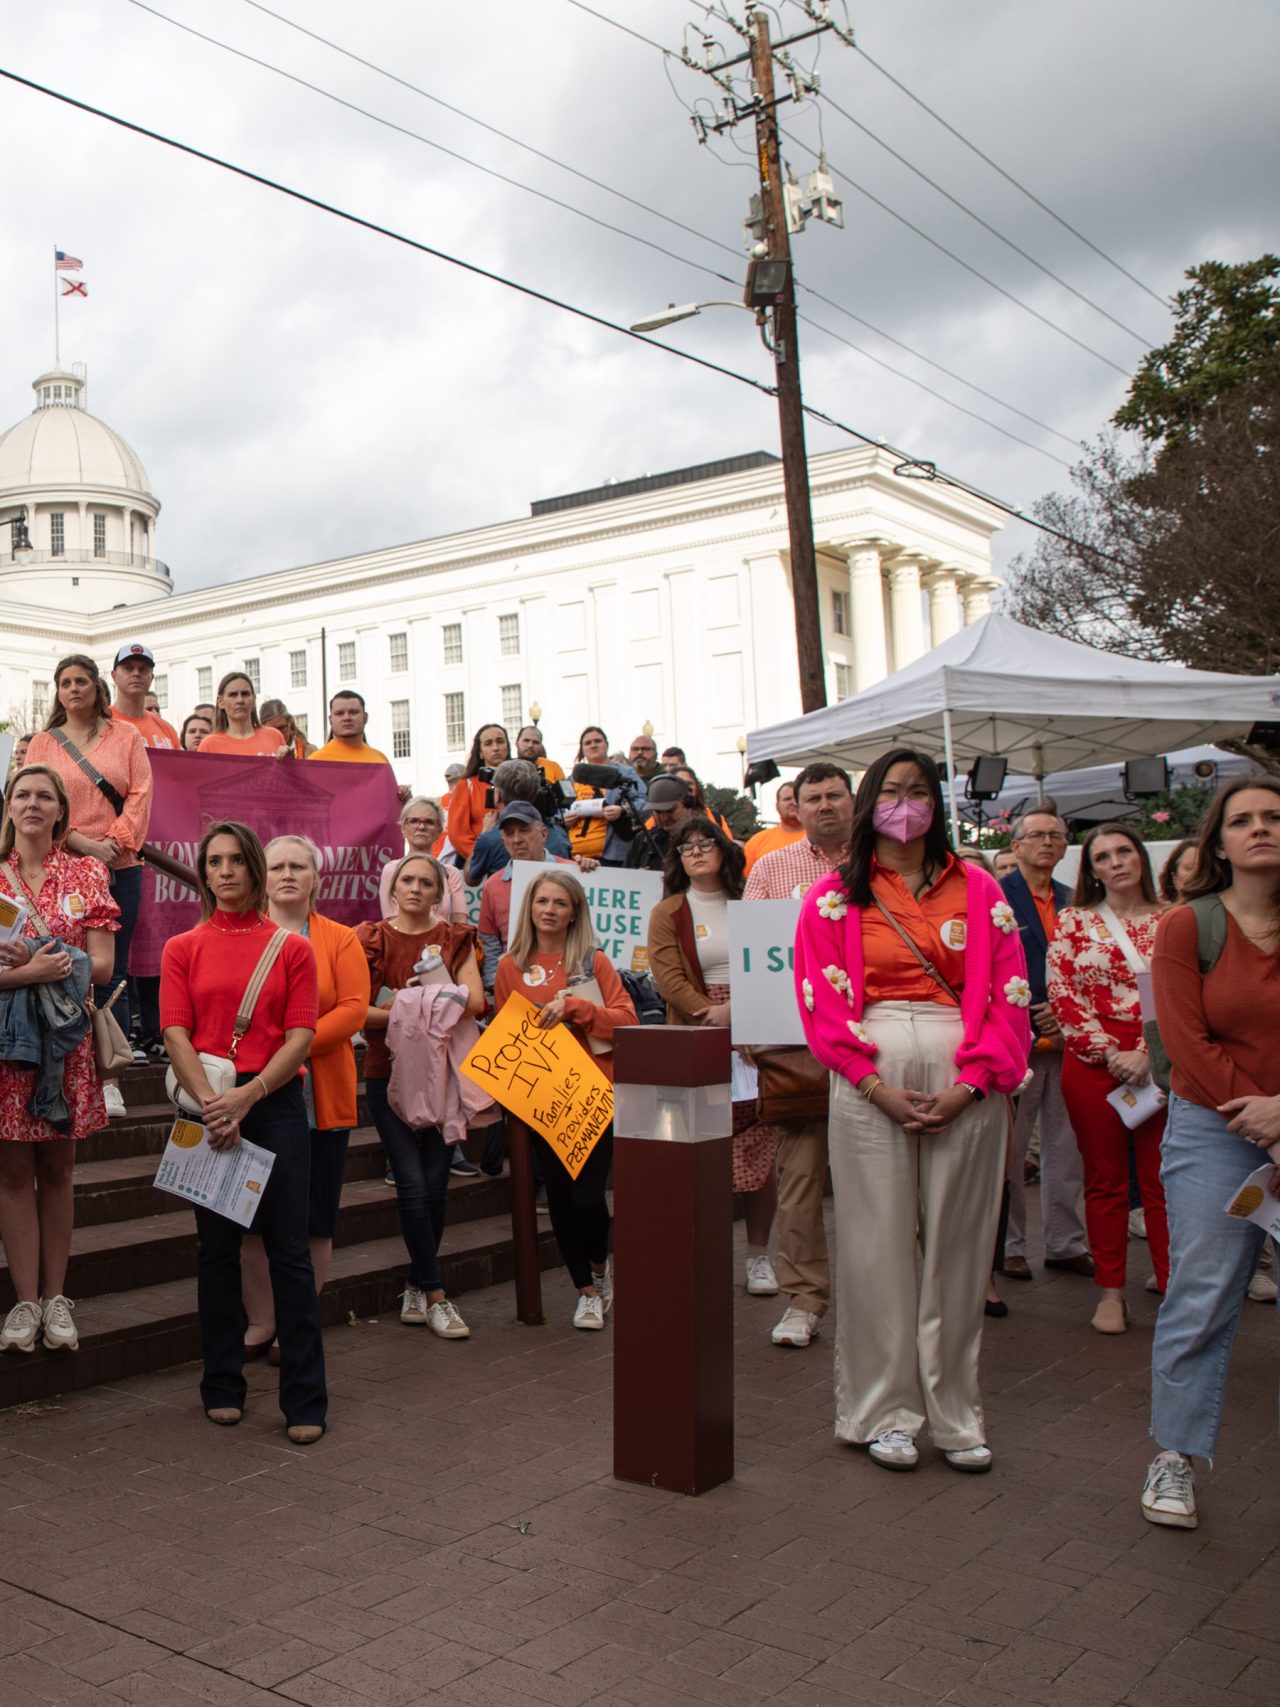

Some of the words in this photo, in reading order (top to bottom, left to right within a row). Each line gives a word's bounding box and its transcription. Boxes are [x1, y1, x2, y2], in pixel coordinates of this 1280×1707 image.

[316, 873, 380, 901] GHTS
[743, 947, 751, 972] I
[508, 1031, 560, 1099] IVF
[533, 1067, 582, 1129] Families
[556, 1084, 601, 1149] Providers
